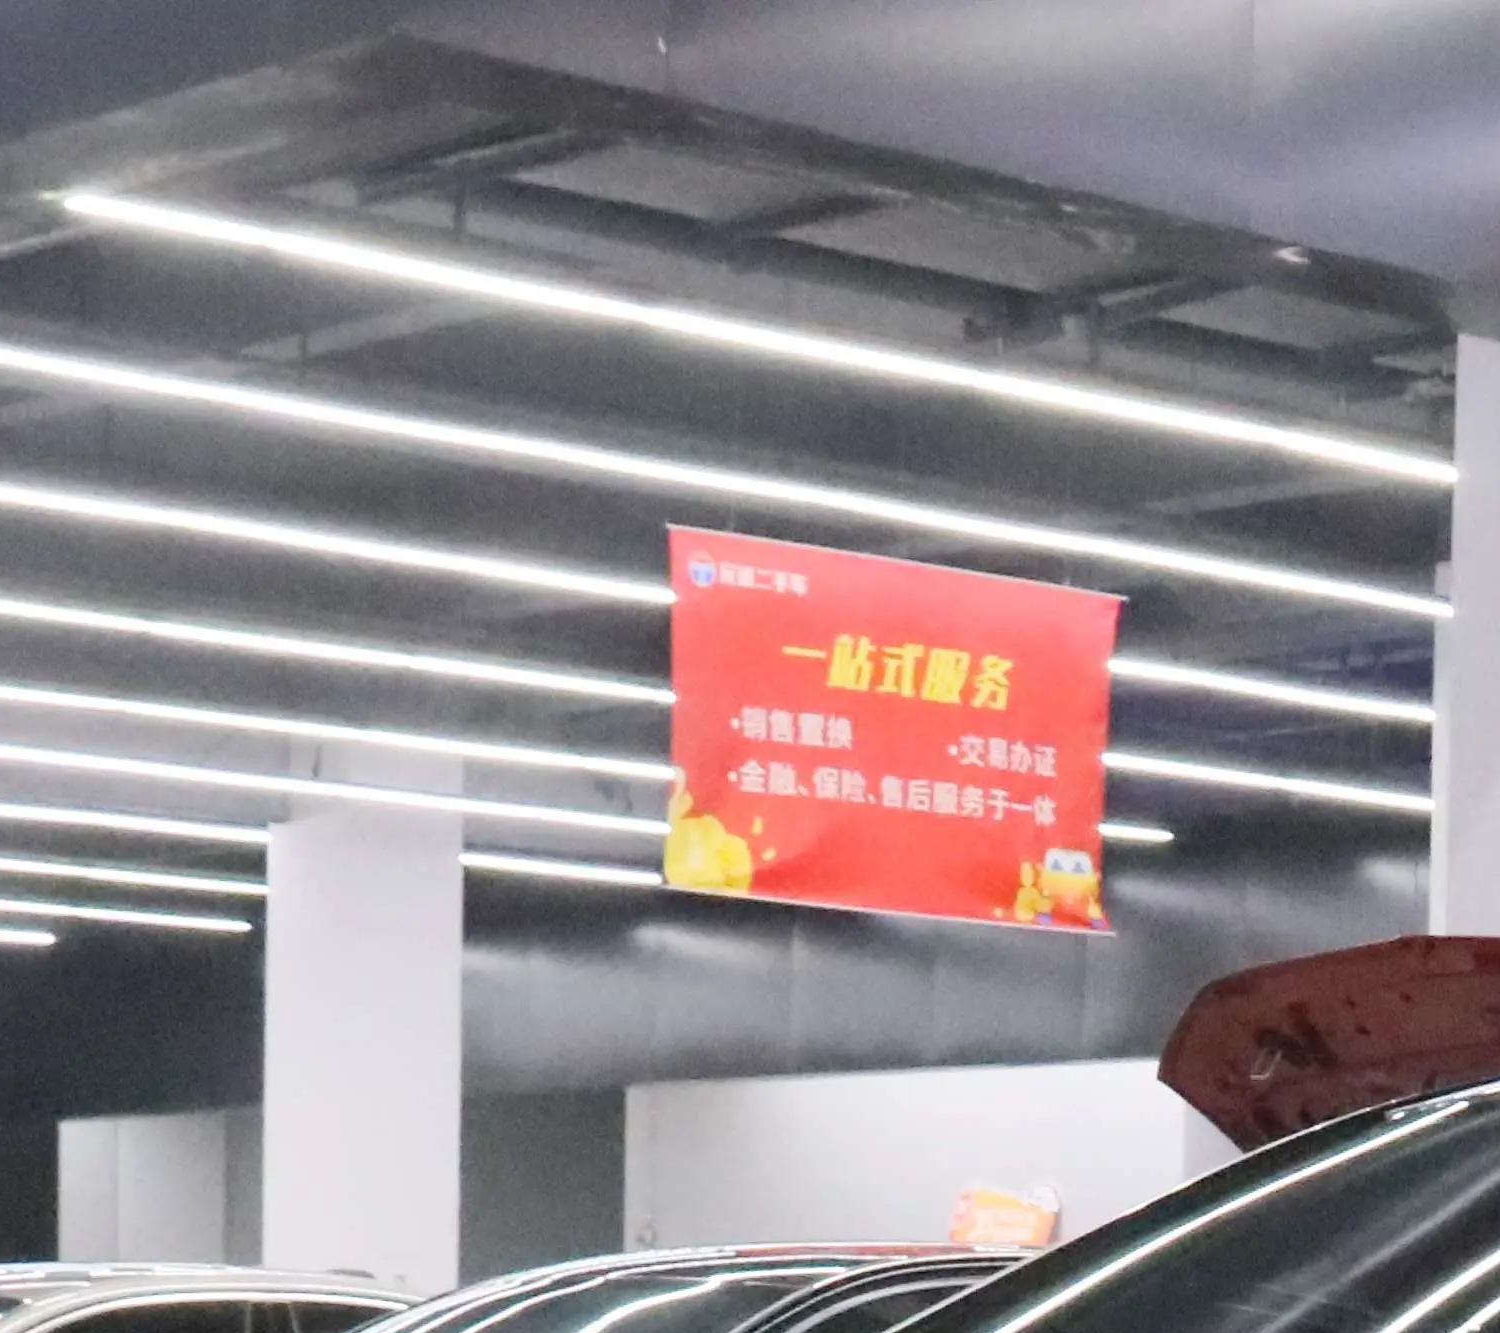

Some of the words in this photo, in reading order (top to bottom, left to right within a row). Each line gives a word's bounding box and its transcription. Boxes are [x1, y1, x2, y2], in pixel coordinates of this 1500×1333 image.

[781, 633, 1016, 711] 一站式服务
[740, 706, 854, 750] 销售置换
[959, 734, 1057, 778] 交易办证
